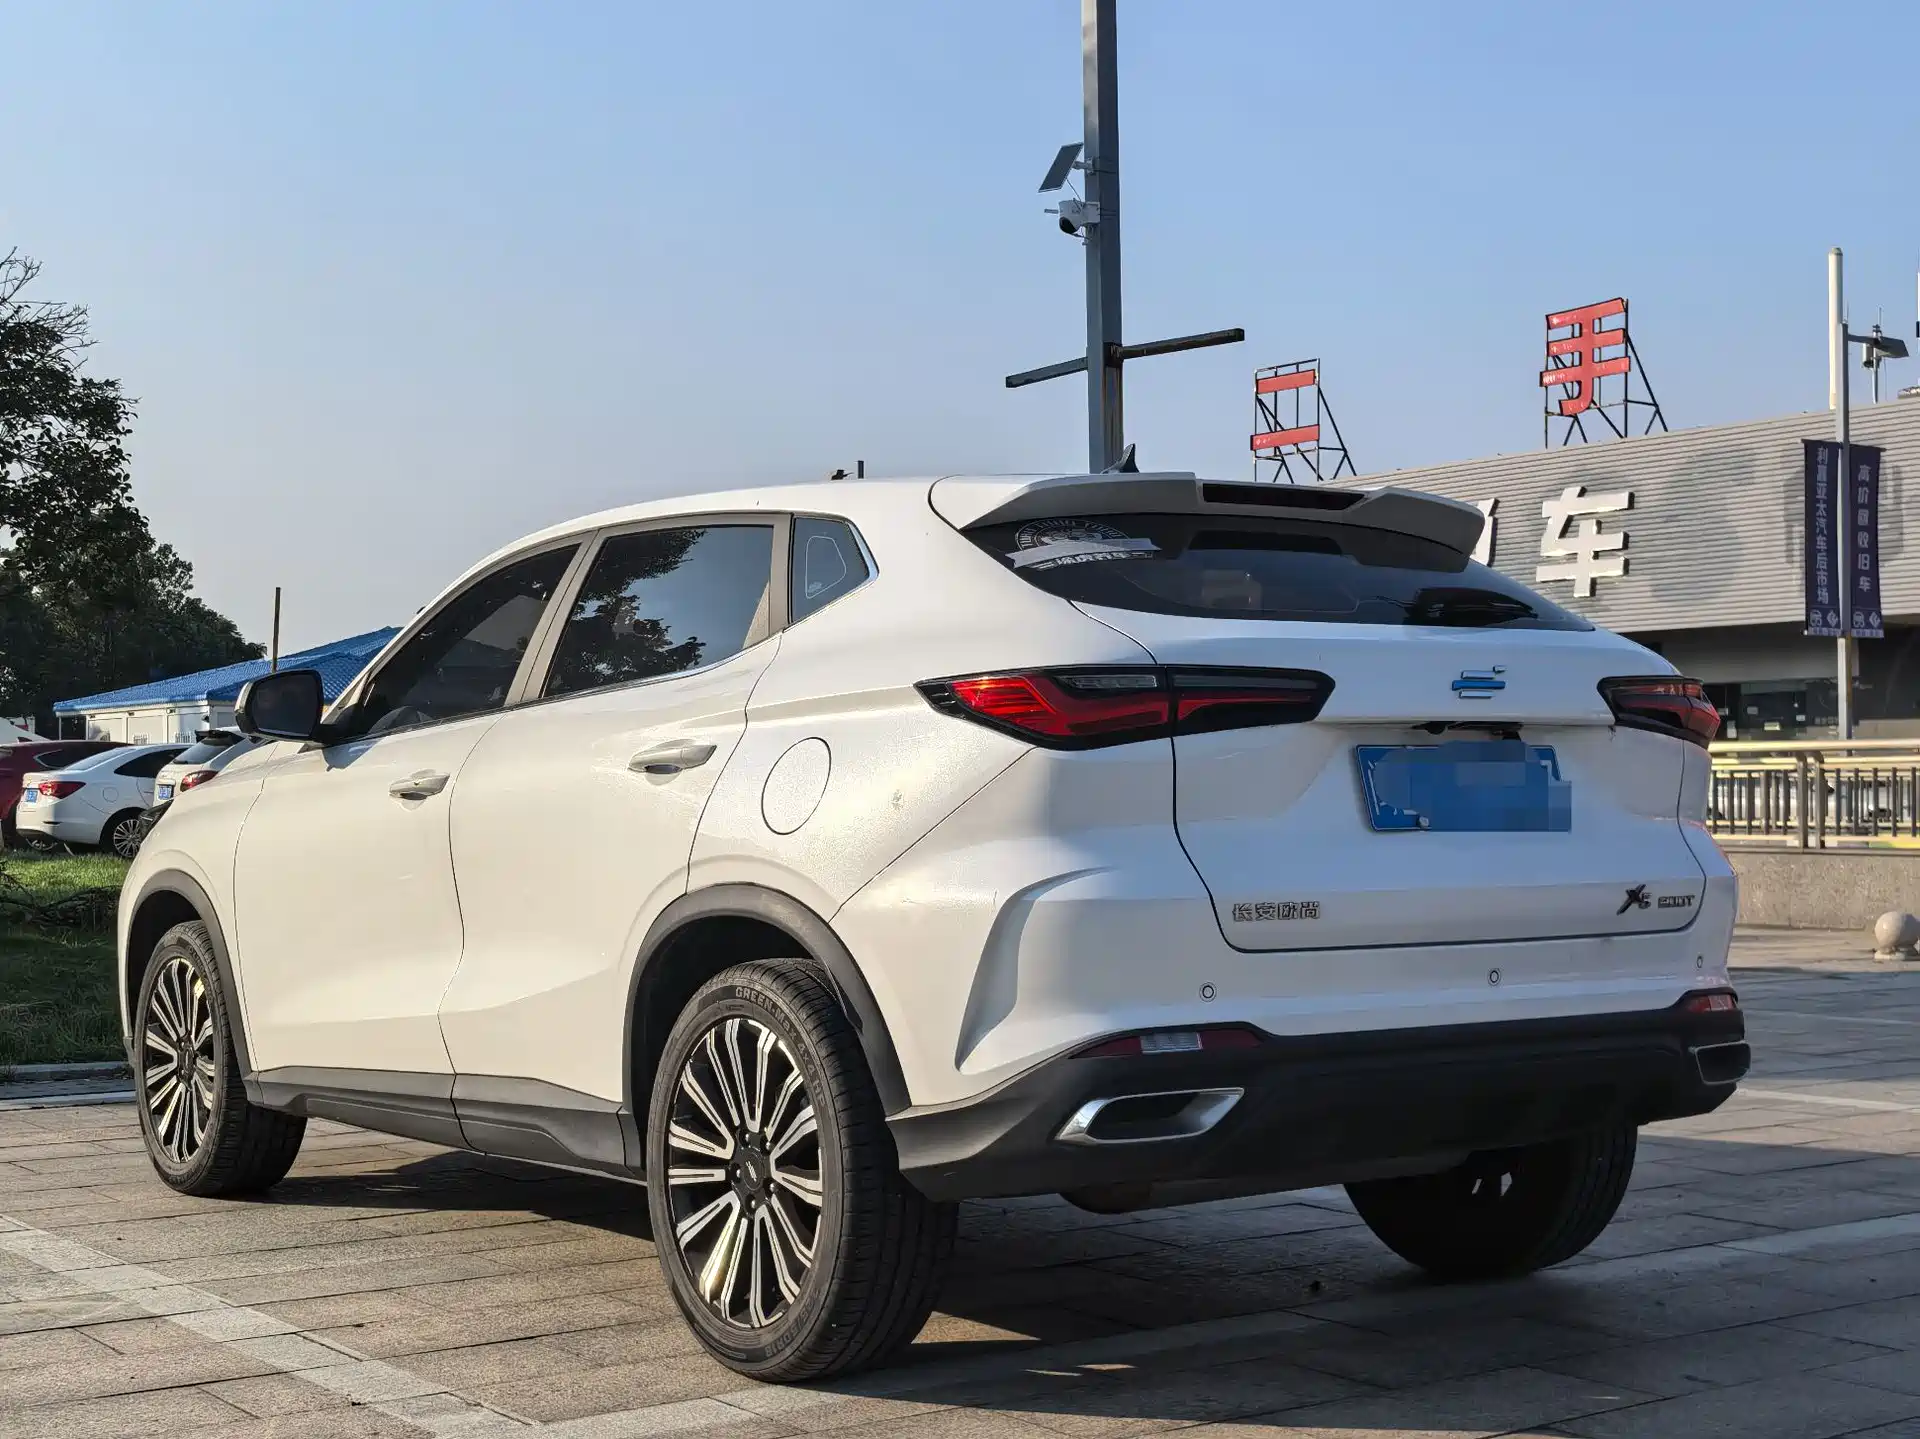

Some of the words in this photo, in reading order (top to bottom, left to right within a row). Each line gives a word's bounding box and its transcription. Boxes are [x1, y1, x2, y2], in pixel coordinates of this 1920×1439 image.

[1474, 486, 1634, 598] 车
[1857, 464, 1872, 593] 高价回收旧车
[1232, 901, 1321, 922] 长安欧尚
